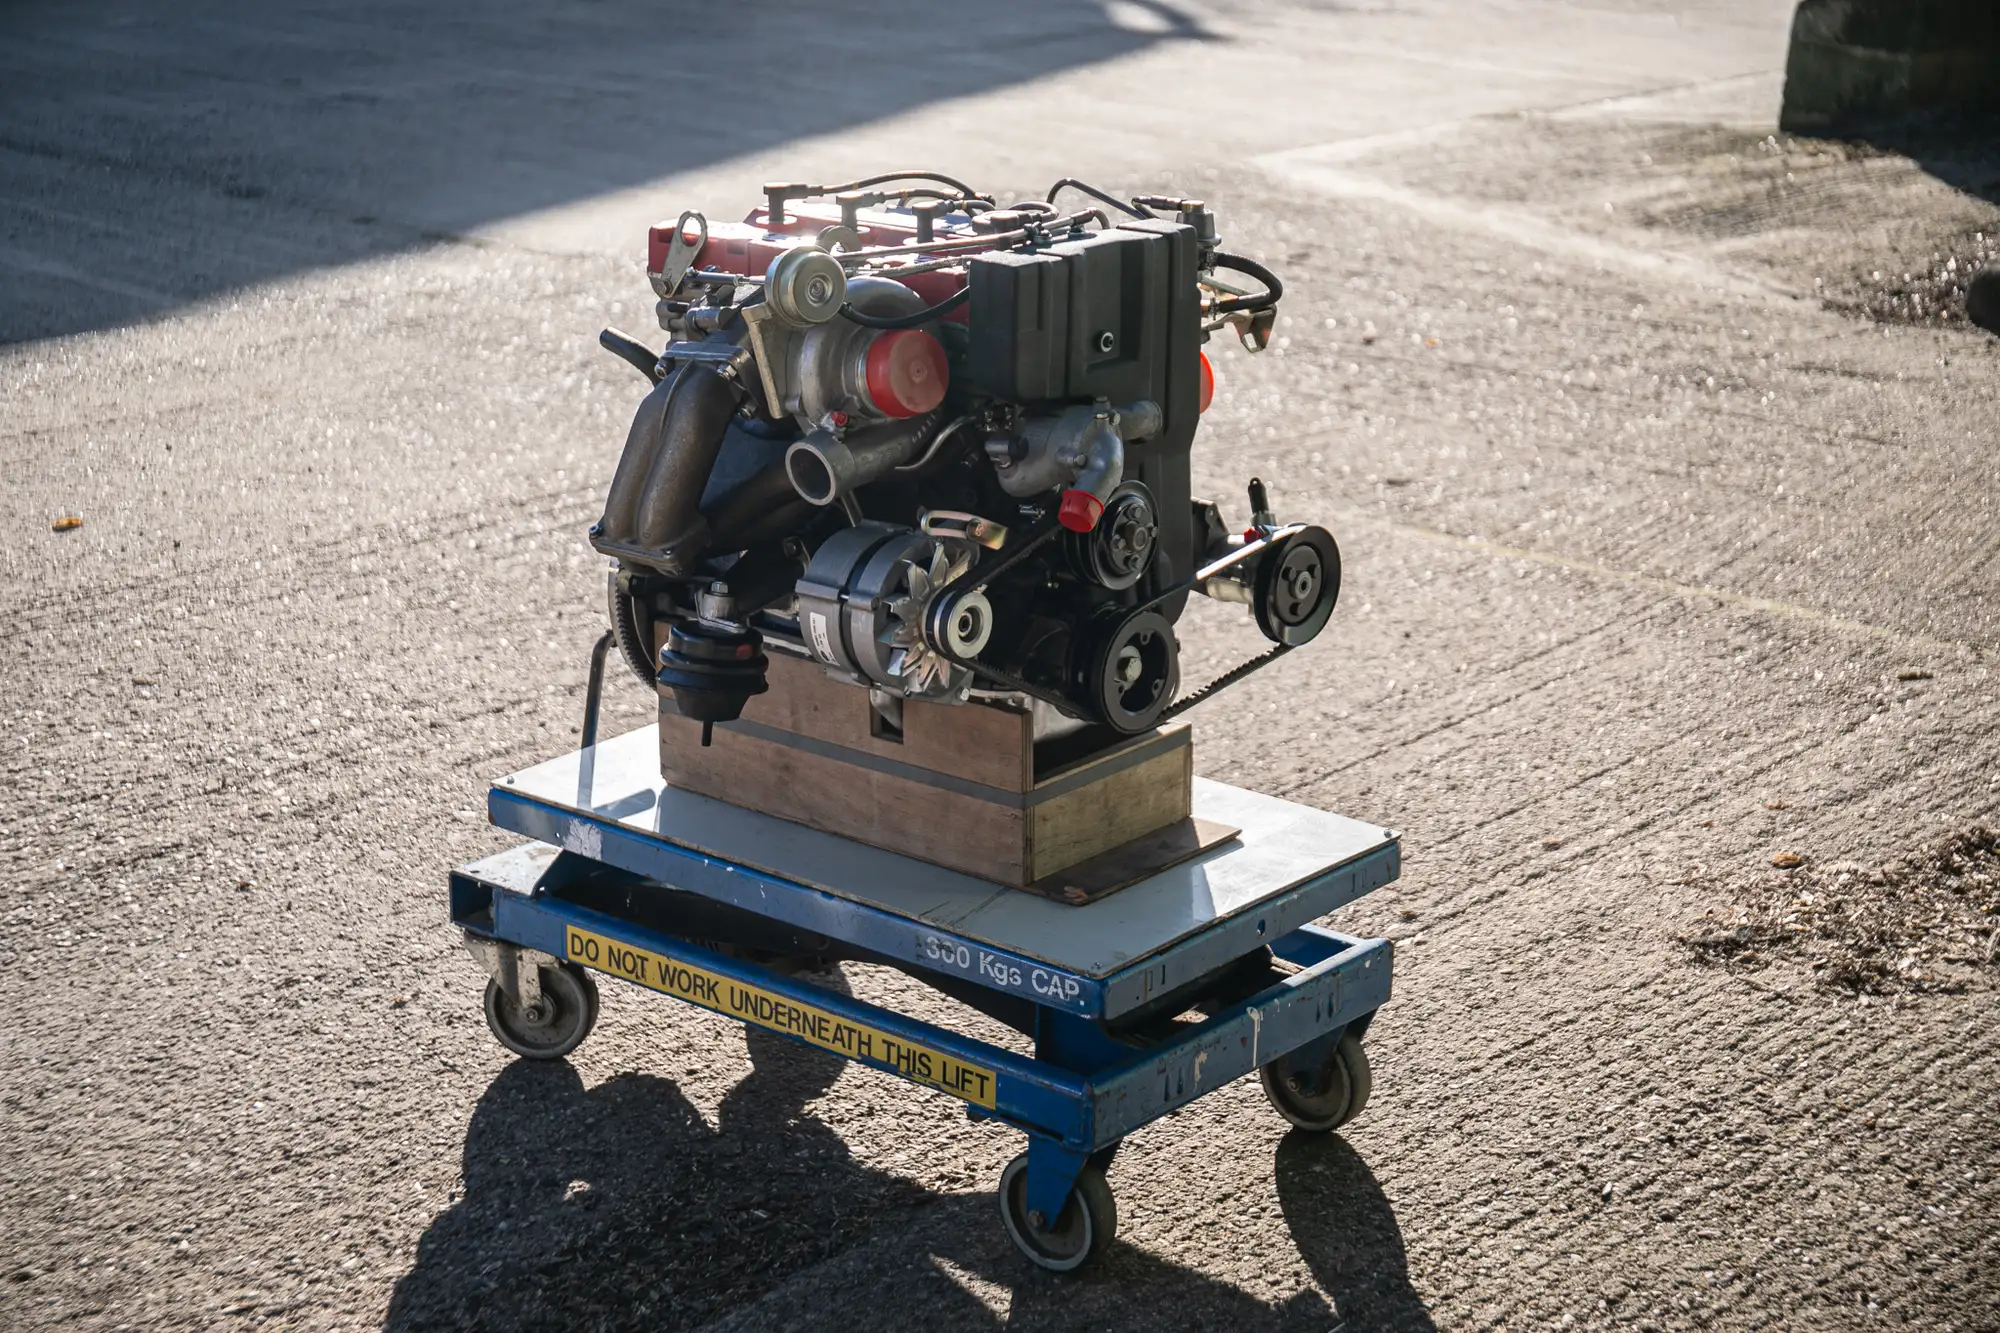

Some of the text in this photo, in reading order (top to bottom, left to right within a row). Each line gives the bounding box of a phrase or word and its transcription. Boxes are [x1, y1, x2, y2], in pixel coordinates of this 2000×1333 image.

[571, 933, 990, 1099] DO NOT WORK UNDERNEATH THIS LIFT
[979, 951, 1022, 986] Kgs
